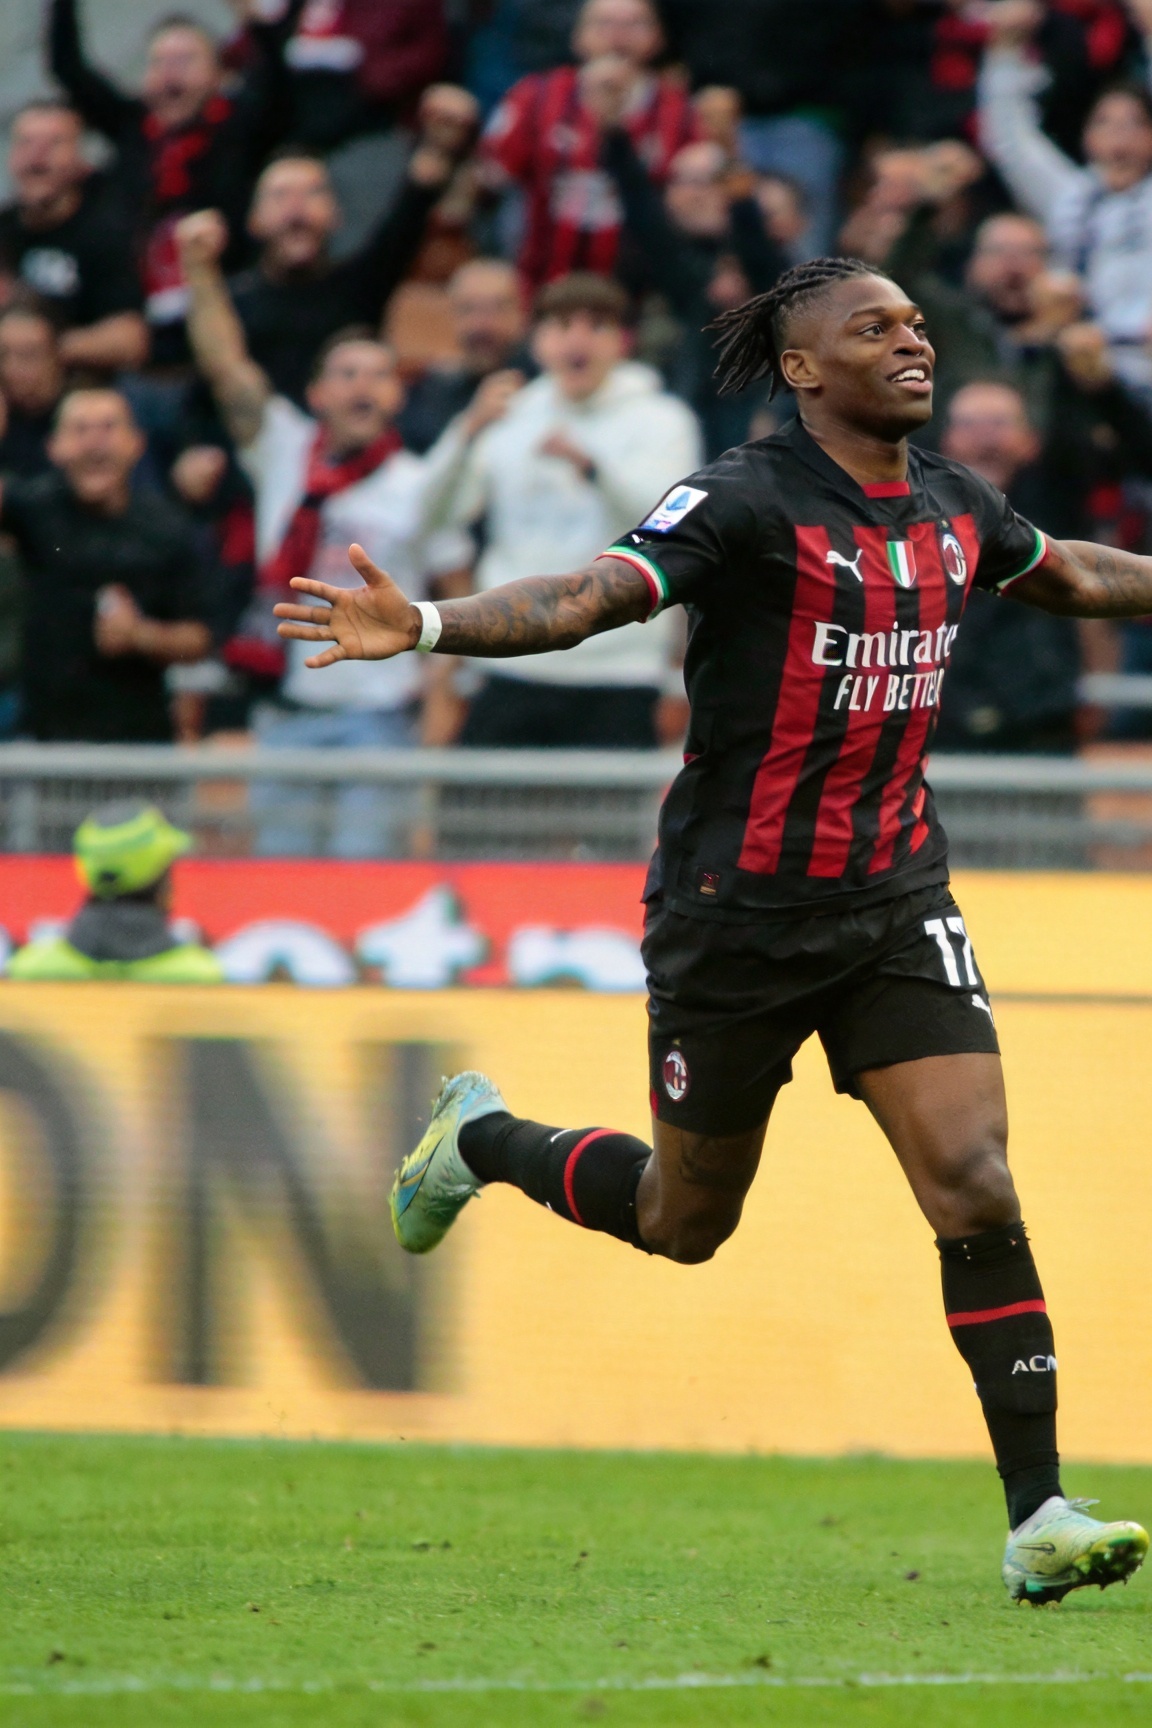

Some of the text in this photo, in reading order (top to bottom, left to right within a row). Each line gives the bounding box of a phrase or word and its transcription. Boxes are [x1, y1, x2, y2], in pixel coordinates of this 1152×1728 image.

[812, 620, 959, 668] Emirate
[833, 673, 880, 712] FLY
[923, 916, 978, 987] 17
